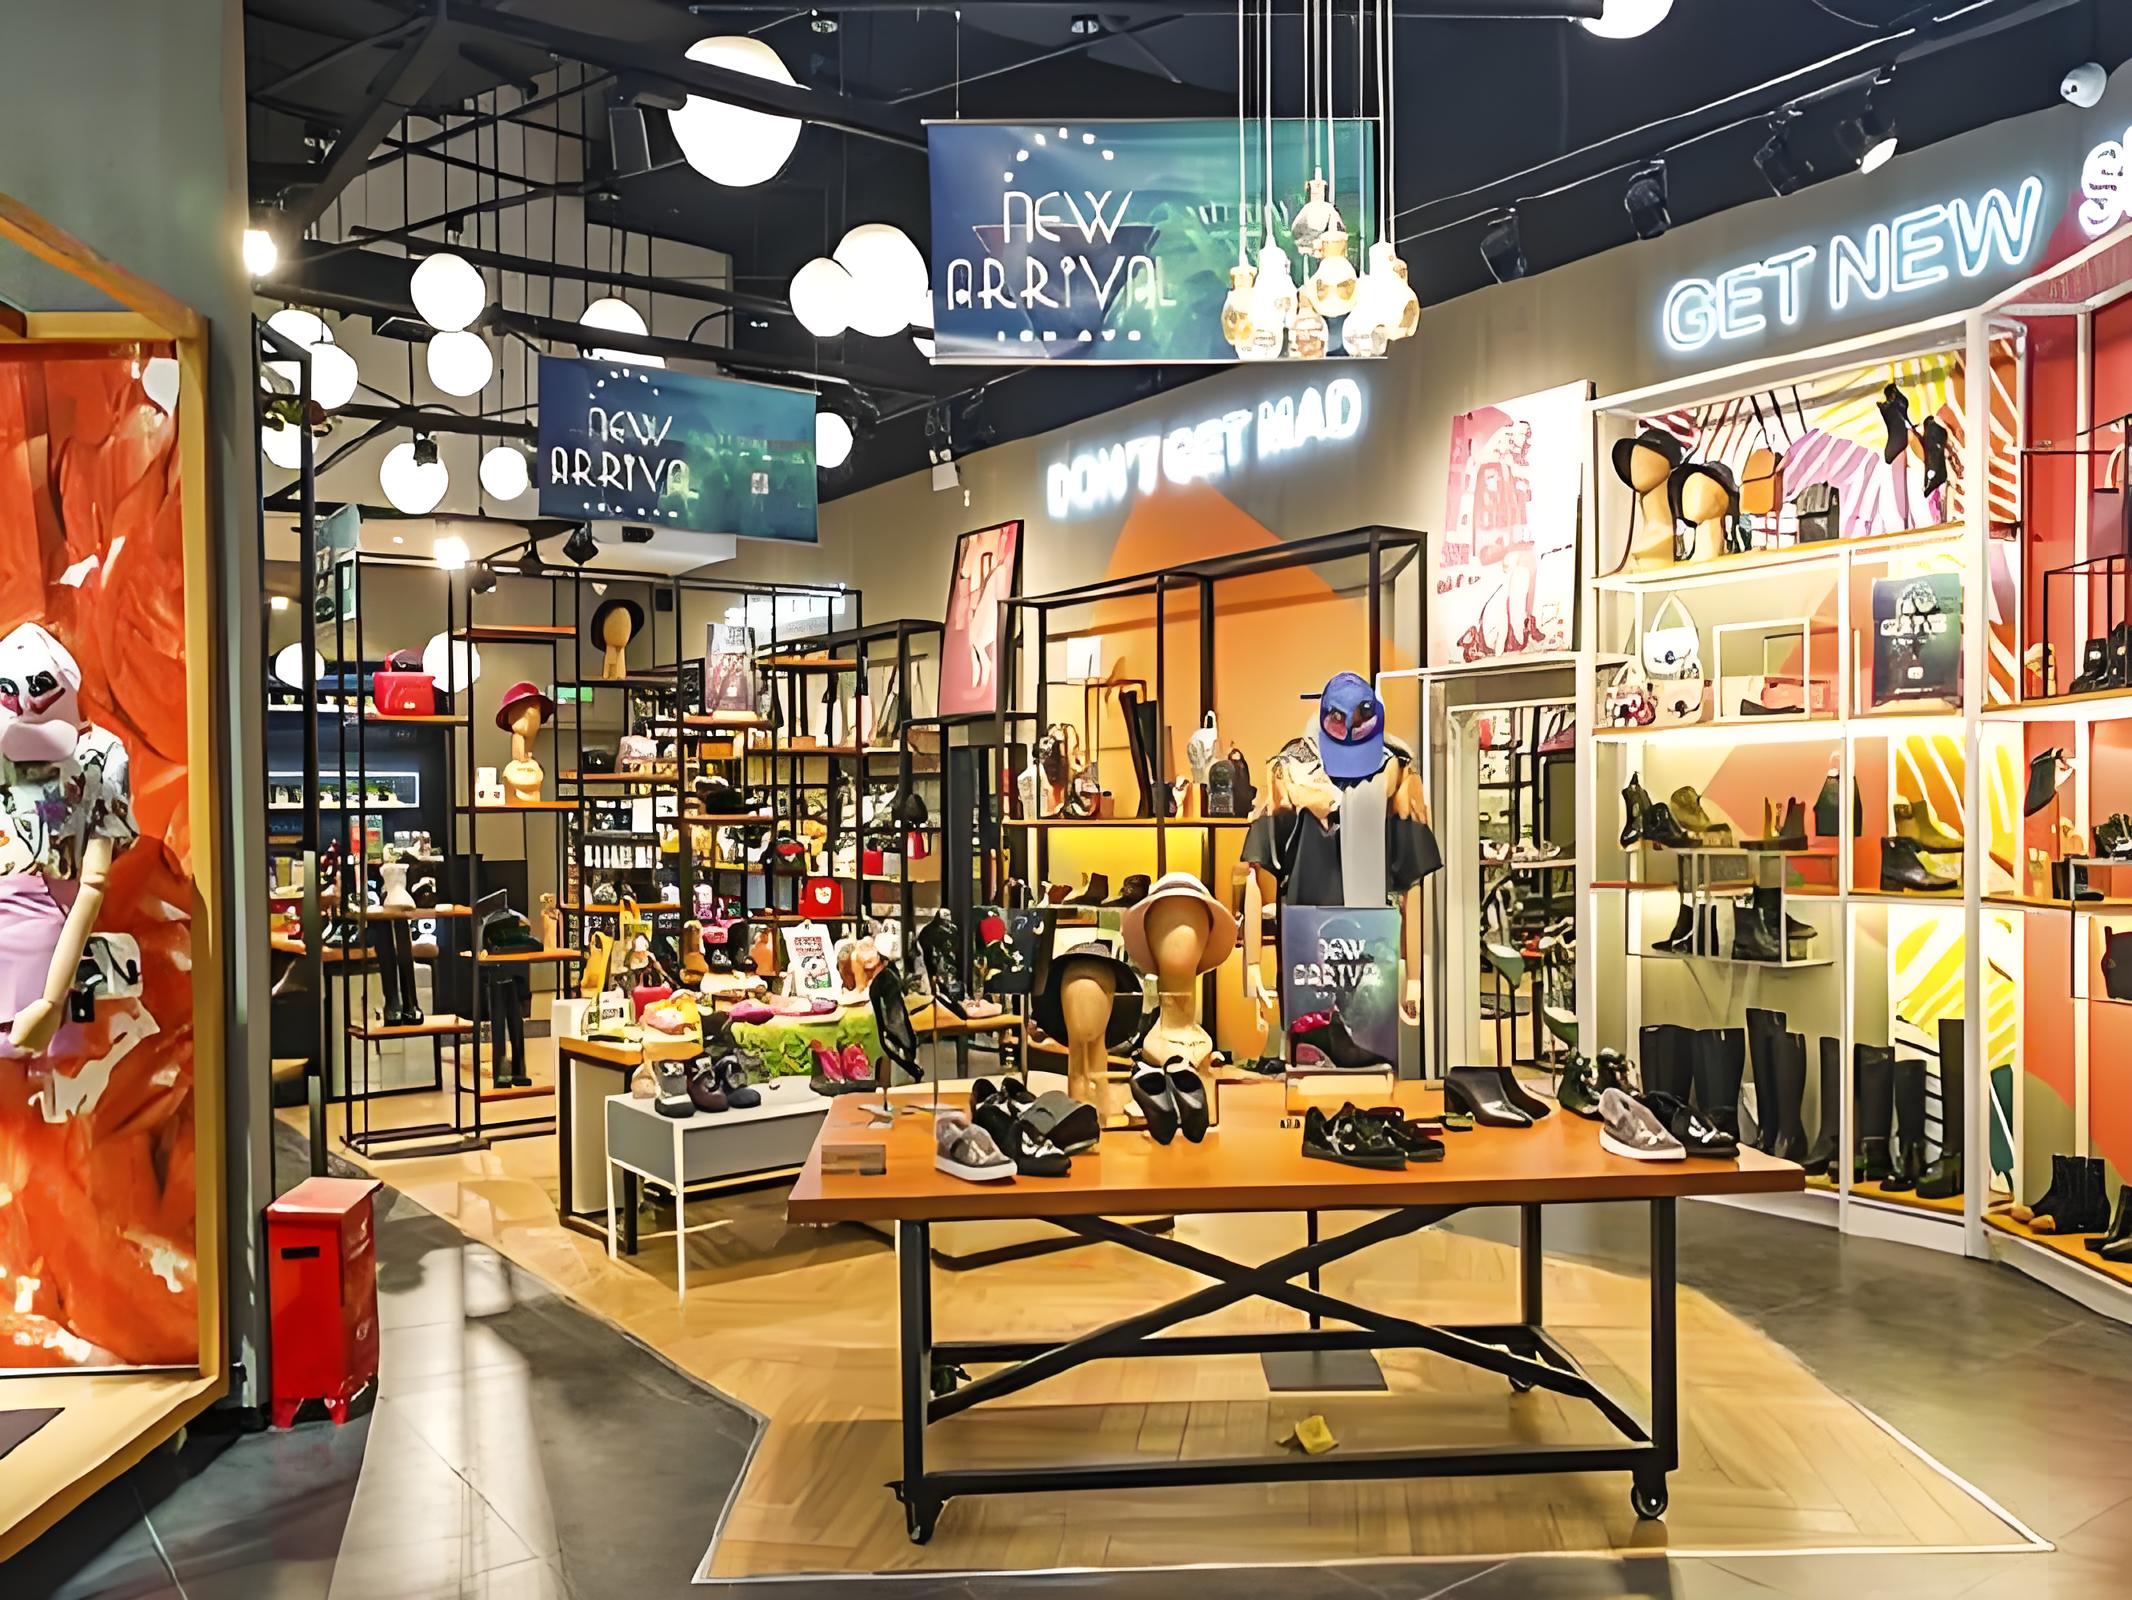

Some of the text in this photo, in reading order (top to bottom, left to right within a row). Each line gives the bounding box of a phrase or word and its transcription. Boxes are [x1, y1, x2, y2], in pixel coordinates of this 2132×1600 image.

[1003, 190, 1133, 244] NEW
[947, 255, 1176, 310] ARRIVAL
[1662, 176, 2043, 351] GET NEW
[588, 407, 672, 447] NEW
[1162, 409, 1252, 485] GET
[1256, 378, 1362, 460] MAD
